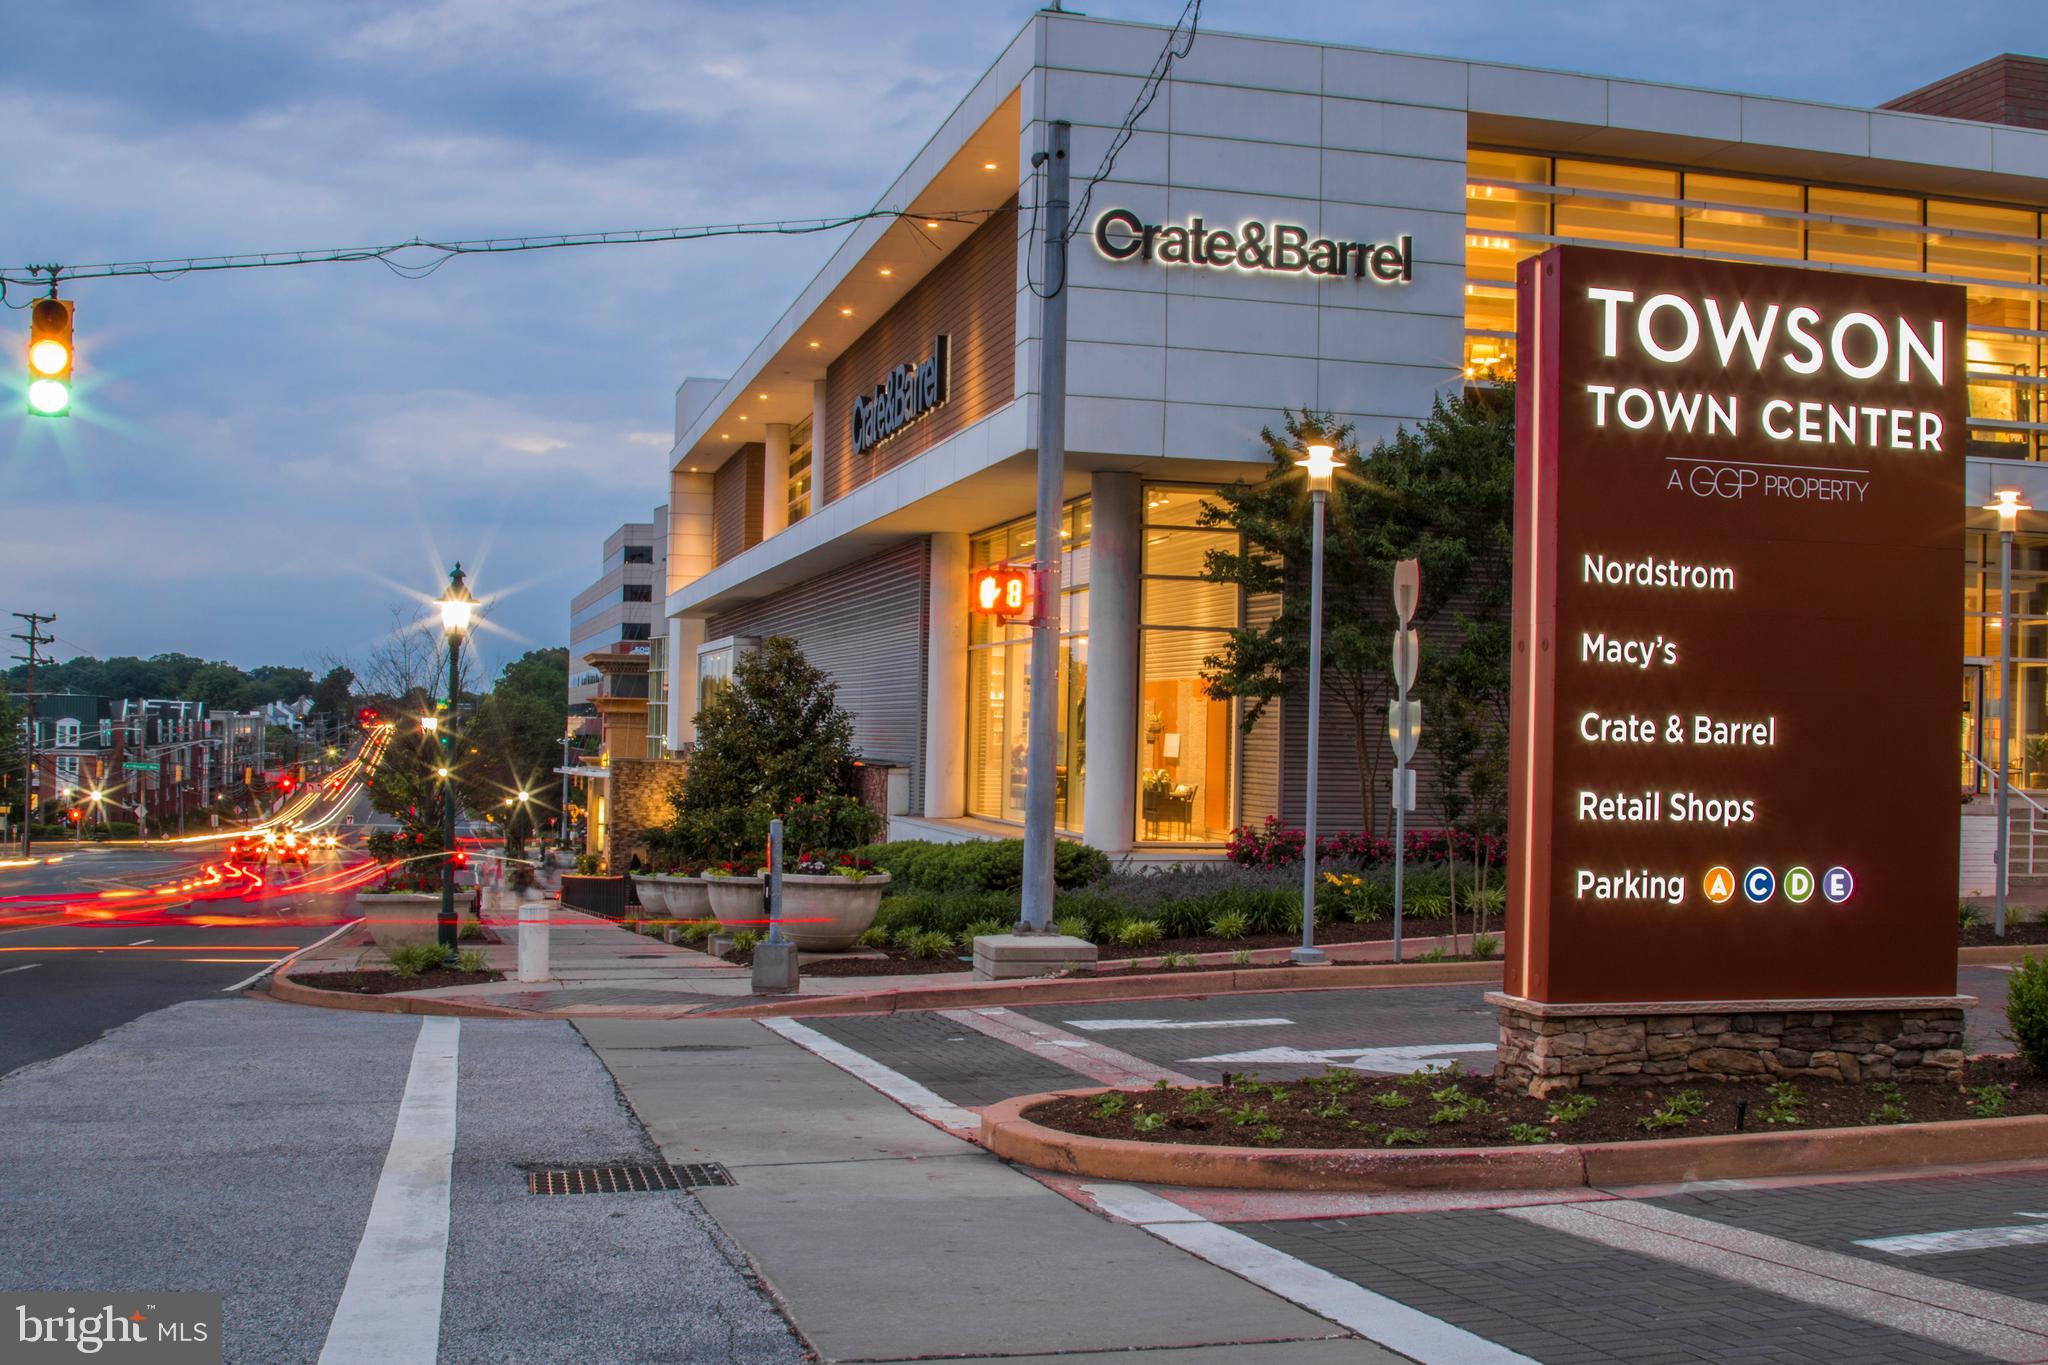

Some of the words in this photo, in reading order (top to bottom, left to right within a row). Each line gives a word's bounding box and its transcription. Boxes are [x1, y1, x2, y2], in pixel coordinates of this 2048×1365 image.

[1095, 208, 1412, 282] Crate&Barrel
[1588, 287, 1945, 385] TOWSON
[852, 335, 948, 455] Crate&Barrel
[1587, 385, 1738, 436] TOWN
[1762, 399, 1944, 451] CENTER
[1667, 469, 1684, 490] A
[1689, 466, 1759, 499] GGP
[1765, 475, 1870, 503] PROPERTY
[1583, 554, 1735, 590] Nordstrom
[1581, 632, 1677, 669] Macy's
[1580, 712, 1657, 743] Crate
[1665, 714, 1685, 743] &
[1694, 715, 1776, 745] Barrel
[1578, 791, 1660, 821] Retail
[1669, 792, 1756, 827] Shops
[1576, 870, 1686, 904] Parking
[1709, 875, 1728, 896] A
[1749, 873, 1768, 896] C
[1791, 874, 1809, 896] D
[1830, 873, 1845, 896] E
